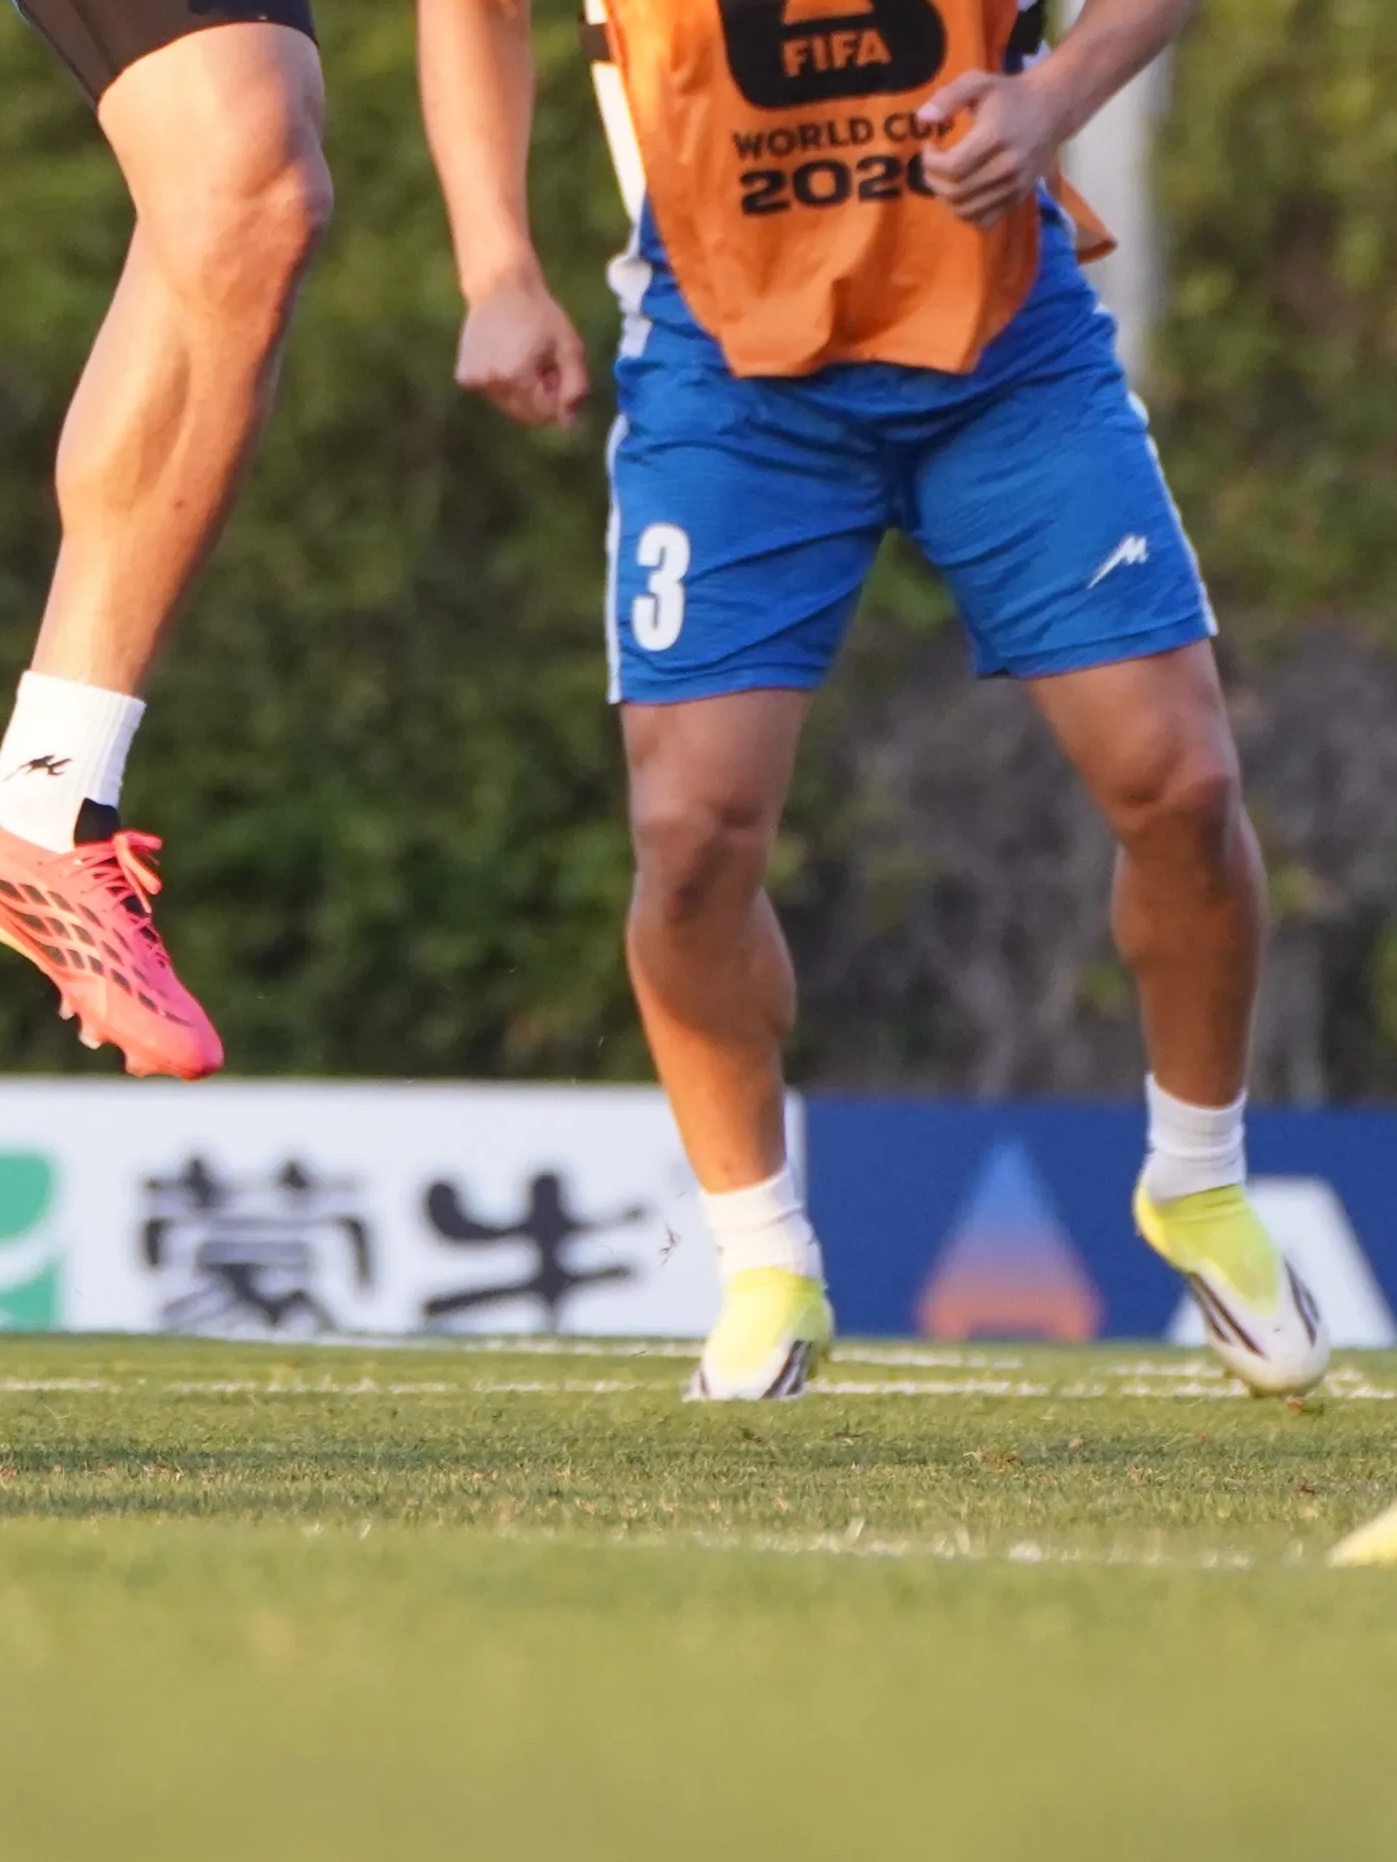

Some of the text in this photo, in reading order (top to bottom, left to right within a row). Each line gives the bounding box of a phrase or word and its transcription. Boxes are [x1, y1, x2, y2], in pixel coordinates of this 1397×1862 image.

[782, 28, 893, 78] FIFA
[733, 117, 875, 159] WORLD
[631, 523, 690, 651] 3
